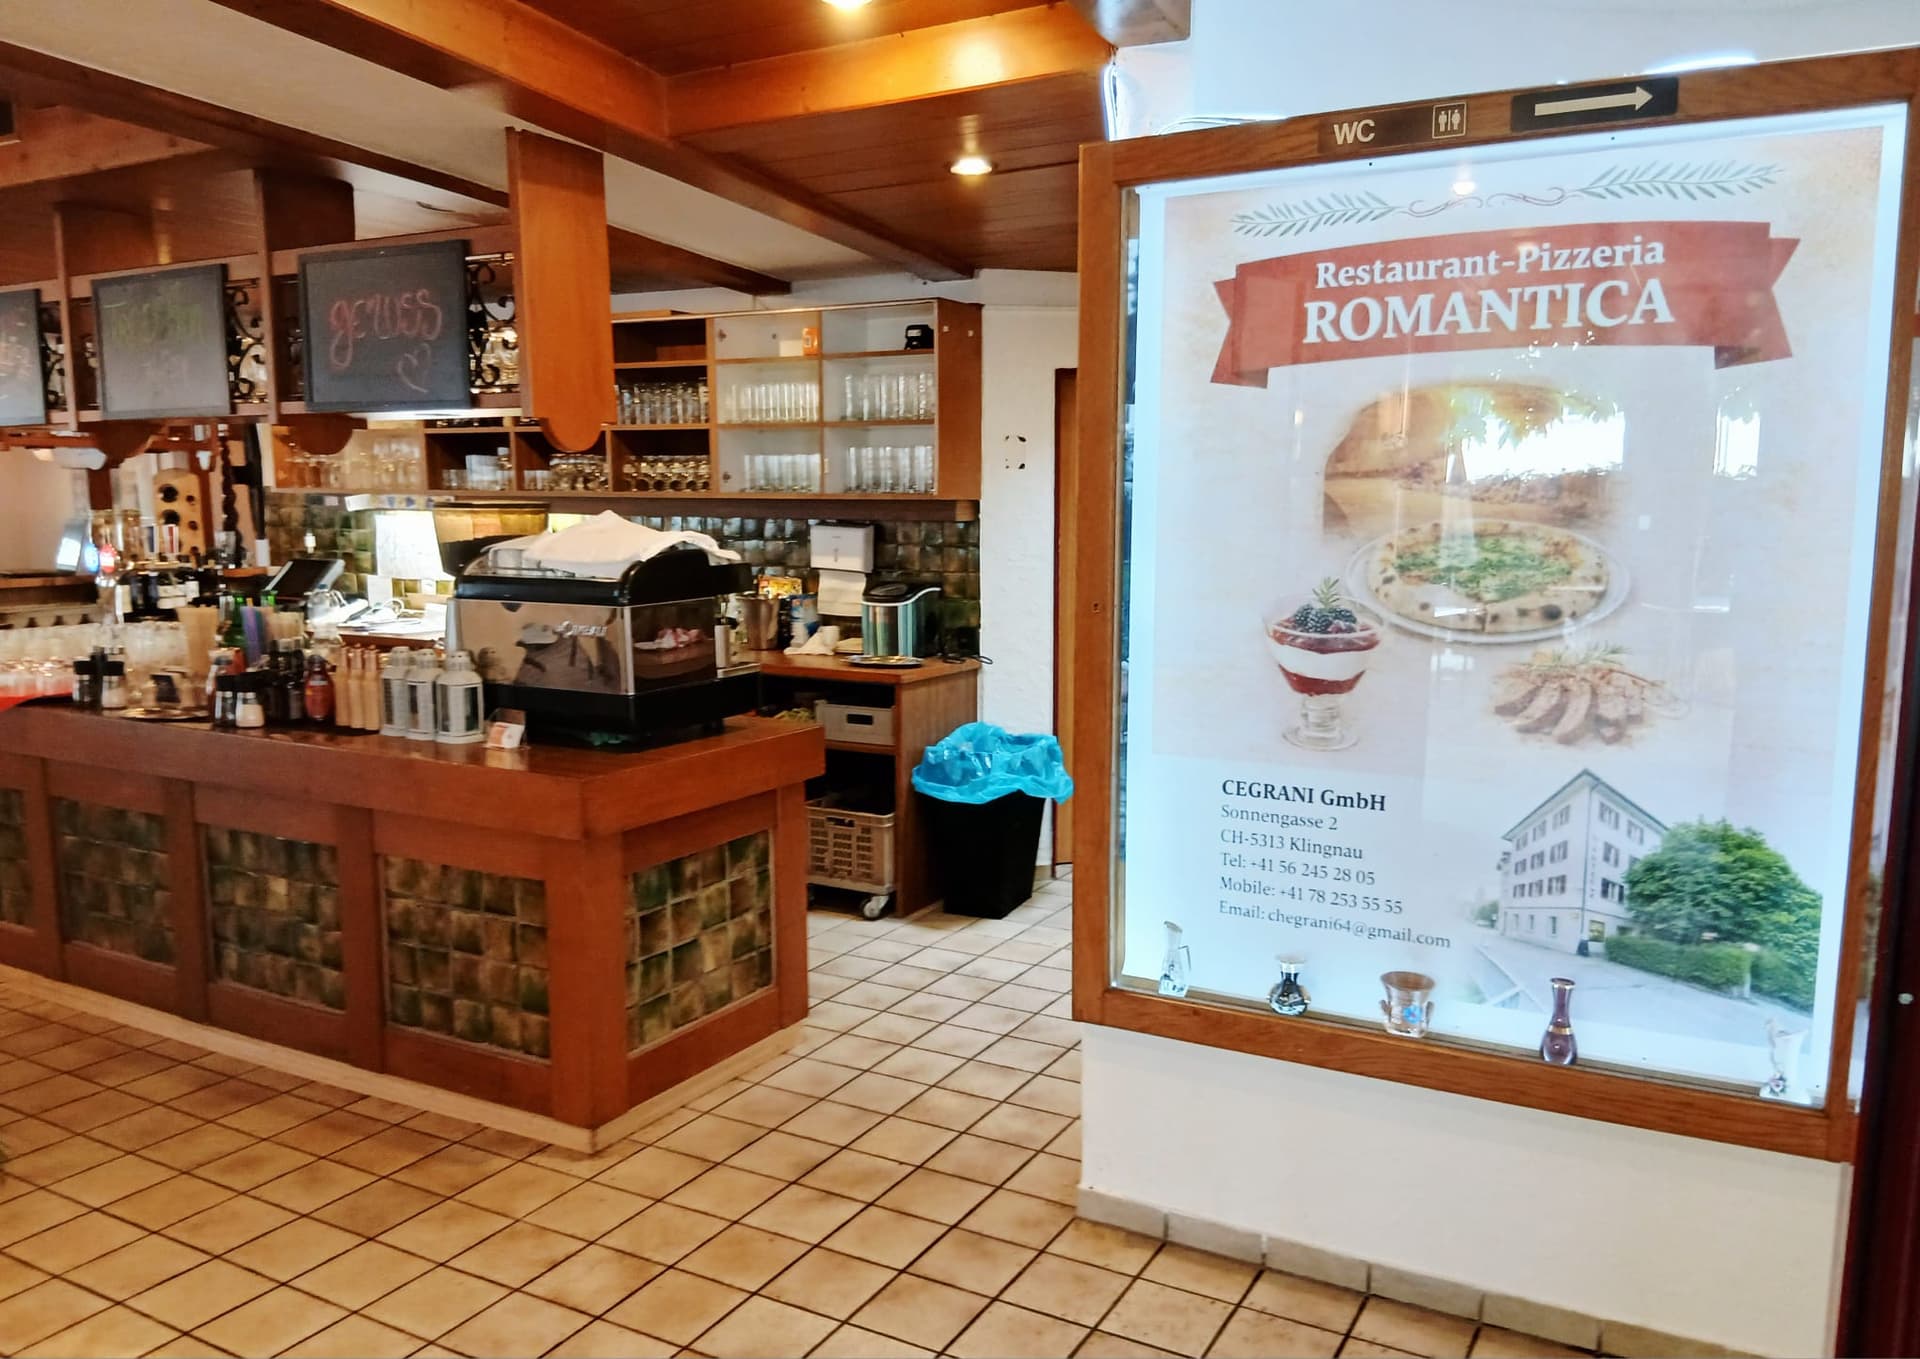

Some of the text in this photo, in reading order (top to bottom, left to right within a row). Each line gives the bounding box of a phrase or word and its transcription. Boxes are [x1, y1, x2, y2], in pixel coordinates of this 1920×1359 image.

[1333, 119, 1375, 145] WC
[1315, 237, 1664, 289] Restaurant-Pizzeria
[1303, 279, 1675, 343] ROMANTICA
[1222, 780, 1386, 811] CEGRANI GmbH
[1221, 806, 1338, 830] Sonnengasse 2
[1221, 829, 1363, 859] CH-5313 Klingnau
[1222, 852, 1375, 885] Tel: +41 56 245 28 05
[1220, 877, 1403, 914] Mobile: +41 78 253 55 55
[1219, 900, 1451, 949] Email: chegrani64@gmail.com
